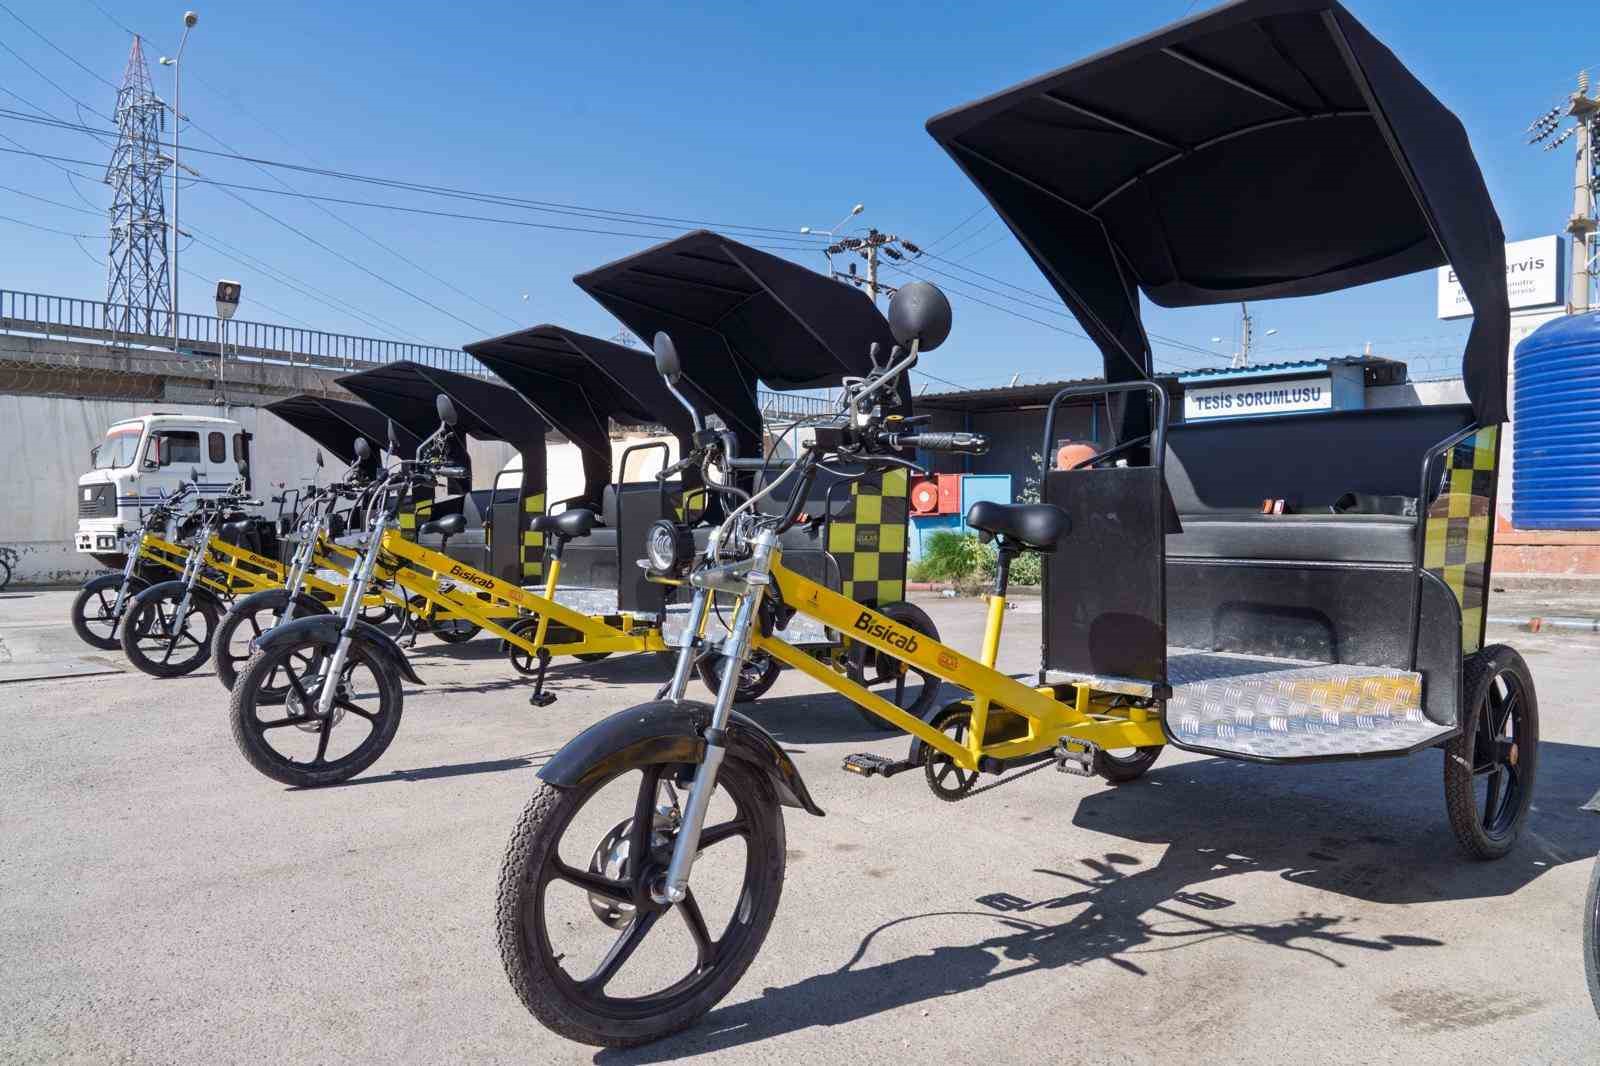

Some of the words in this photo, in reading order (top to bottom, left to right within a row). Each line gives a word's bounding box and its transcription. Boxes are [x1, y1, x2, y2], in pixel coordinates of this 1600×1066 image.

[1196, 392, 1233, 410] TESİS
[1236, 387, 1321, 407] SORUMLUSU
[450, 565, 495, 589] Bisicab
[854, 611, 918, 654] Bisicab
